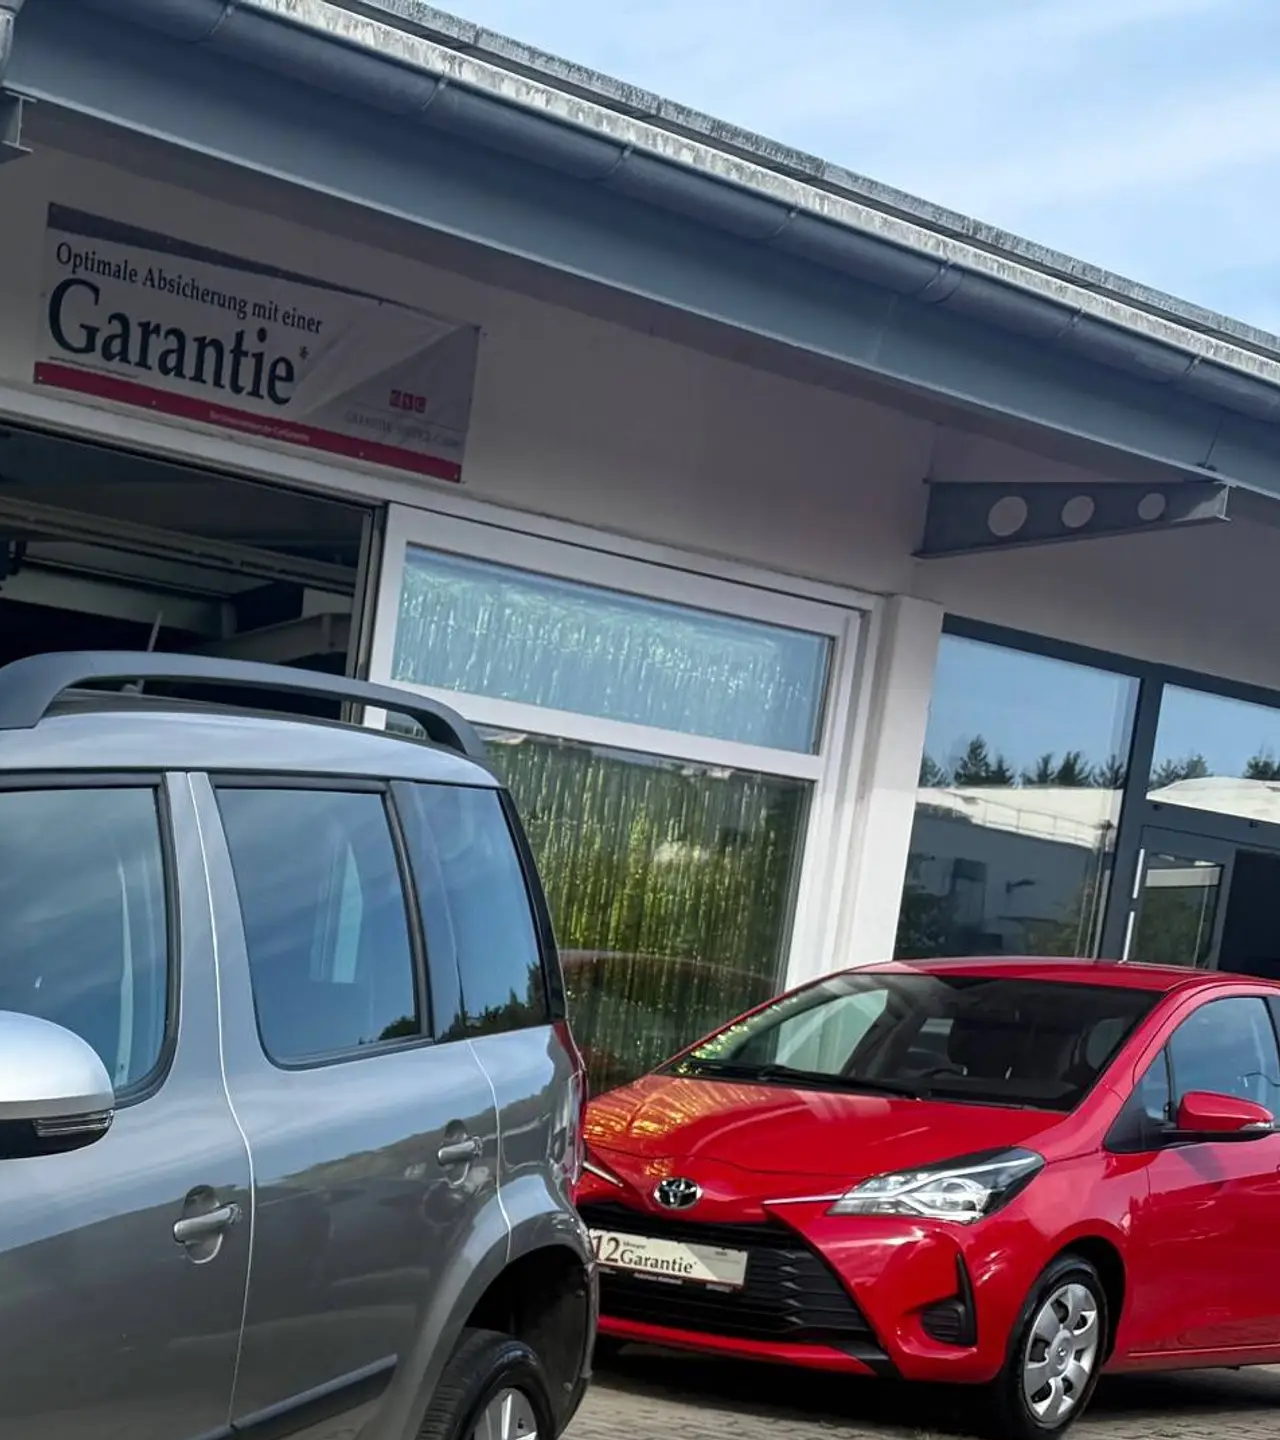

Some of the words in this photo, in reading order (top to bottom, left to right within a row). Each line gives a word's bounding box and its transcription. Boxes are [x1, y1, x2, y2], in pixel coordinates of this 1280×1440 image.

[56, 241, 138, 284] Optimale
[142, 267, 246, 321] Absicherung
[252, 300, 279, 324] mit
[282, 307, 323, 335] einer
